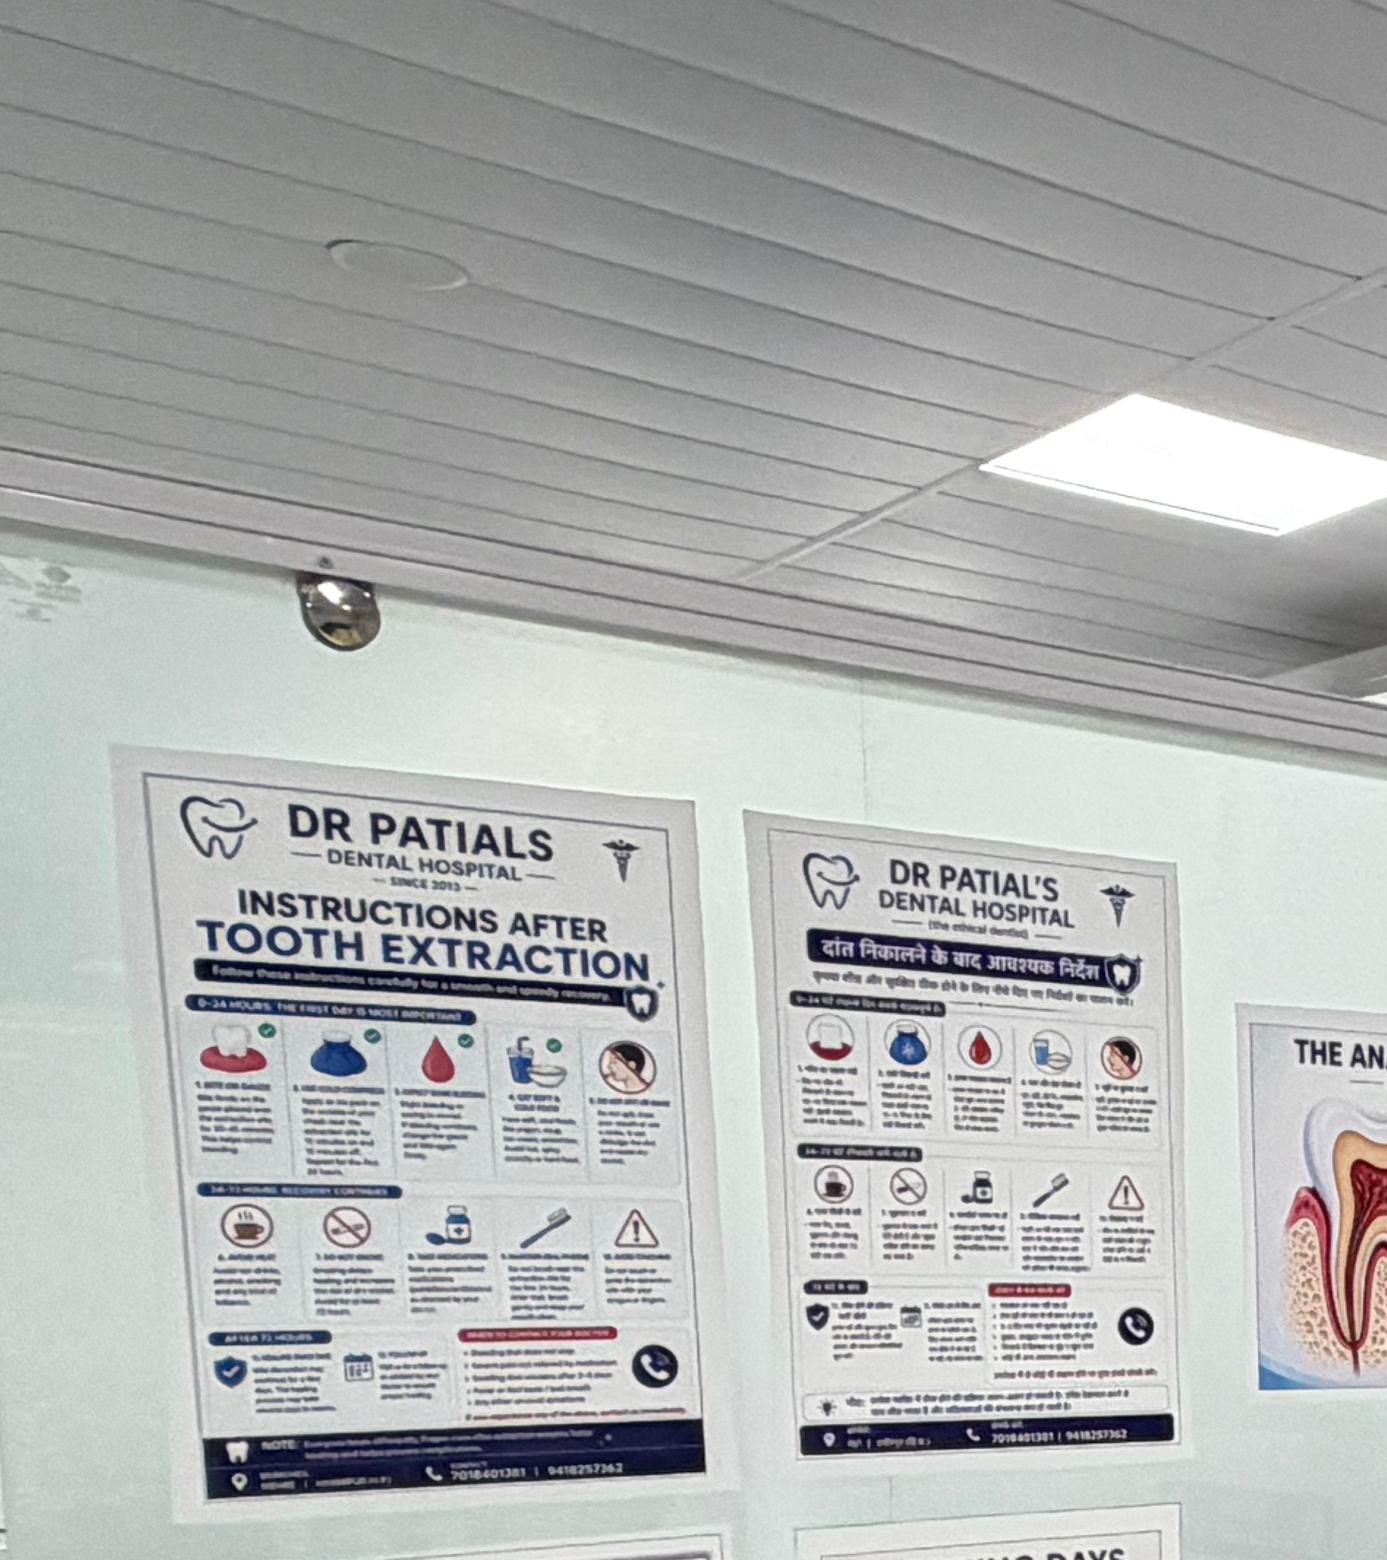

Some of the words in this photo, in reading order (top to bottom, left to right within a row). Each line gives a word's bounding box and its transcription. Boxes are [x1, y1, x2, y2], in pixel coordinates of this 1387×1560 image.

[288, 803, 352, 843] DR
[369, 812, 554, 861] PATIALS
[327, 848, 412, 872] DENTAL
[418, 858, 521, 881] HOSPITAL
[889, 859, 929, 888] DR
[940, 865, 1059, 901] PATIAL'S
[238, 889, 499, 934] INSTRUCTIONS
[510, 913, 607, 943] AFTER
[879, 890, 965, 918] DENTAL
[973, 901, 1075, 928] HOSPITAL
[197, 920, 364, 962] TOOTH
[382, 935, 650, 981] EXTRACTION
[821, 937, 854, 957] दांत
[859, 938, 926, 964] निकालने
[932, 943, 948, 966] के
[952, 951, 981, 970] बाद
[987, 953, 1055, 975] आवश्यक
[1059, 956, 1099, 980] निर्देश
[1294, 1039, 1343, 1067] THE
[451, 1468, 526, 1480] 7018401381
[548, 1463, 623, 1476] 9418257362
